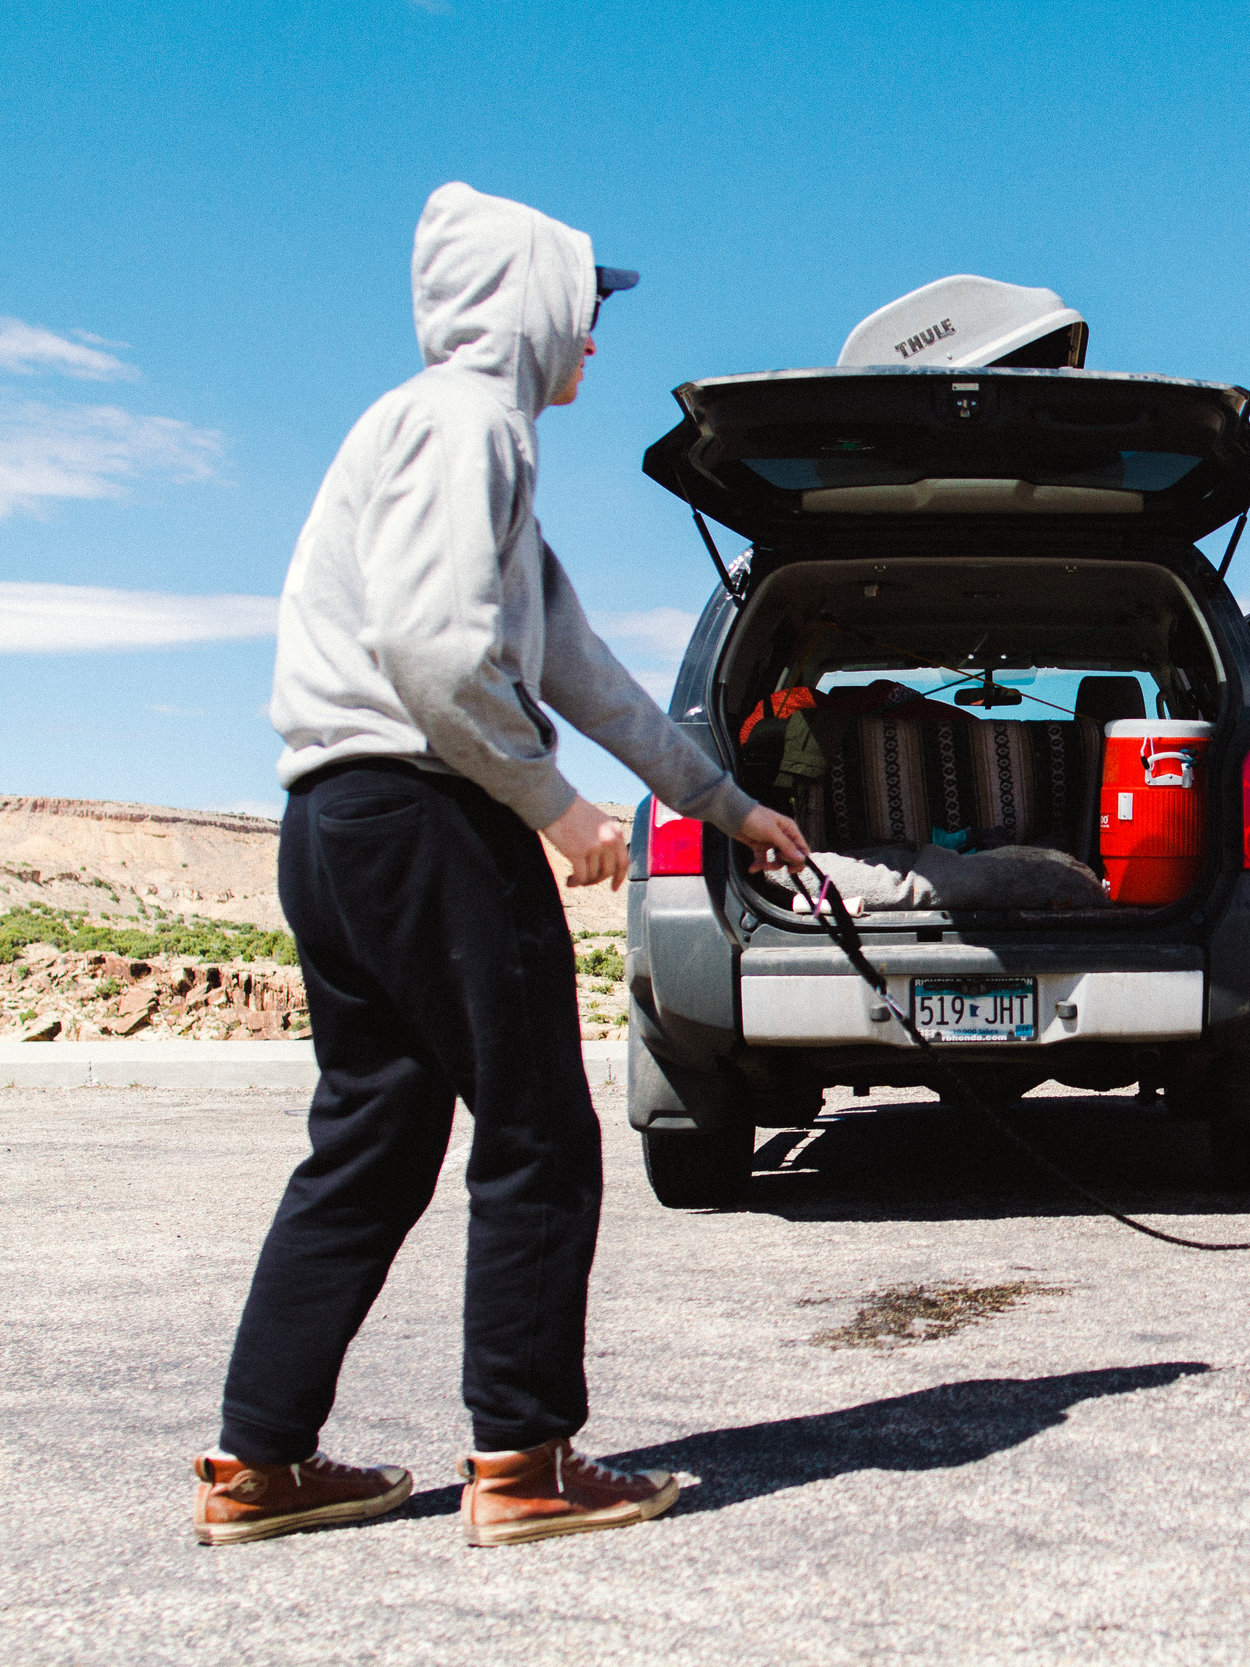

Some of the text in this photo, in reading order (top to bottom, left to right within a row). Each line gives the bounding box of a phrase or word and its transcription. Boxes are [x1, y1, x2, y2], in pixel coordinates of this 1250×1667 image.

[895, 318, 956, 358] THULE
[920, 995, 1028, 1025] 519 JHT
